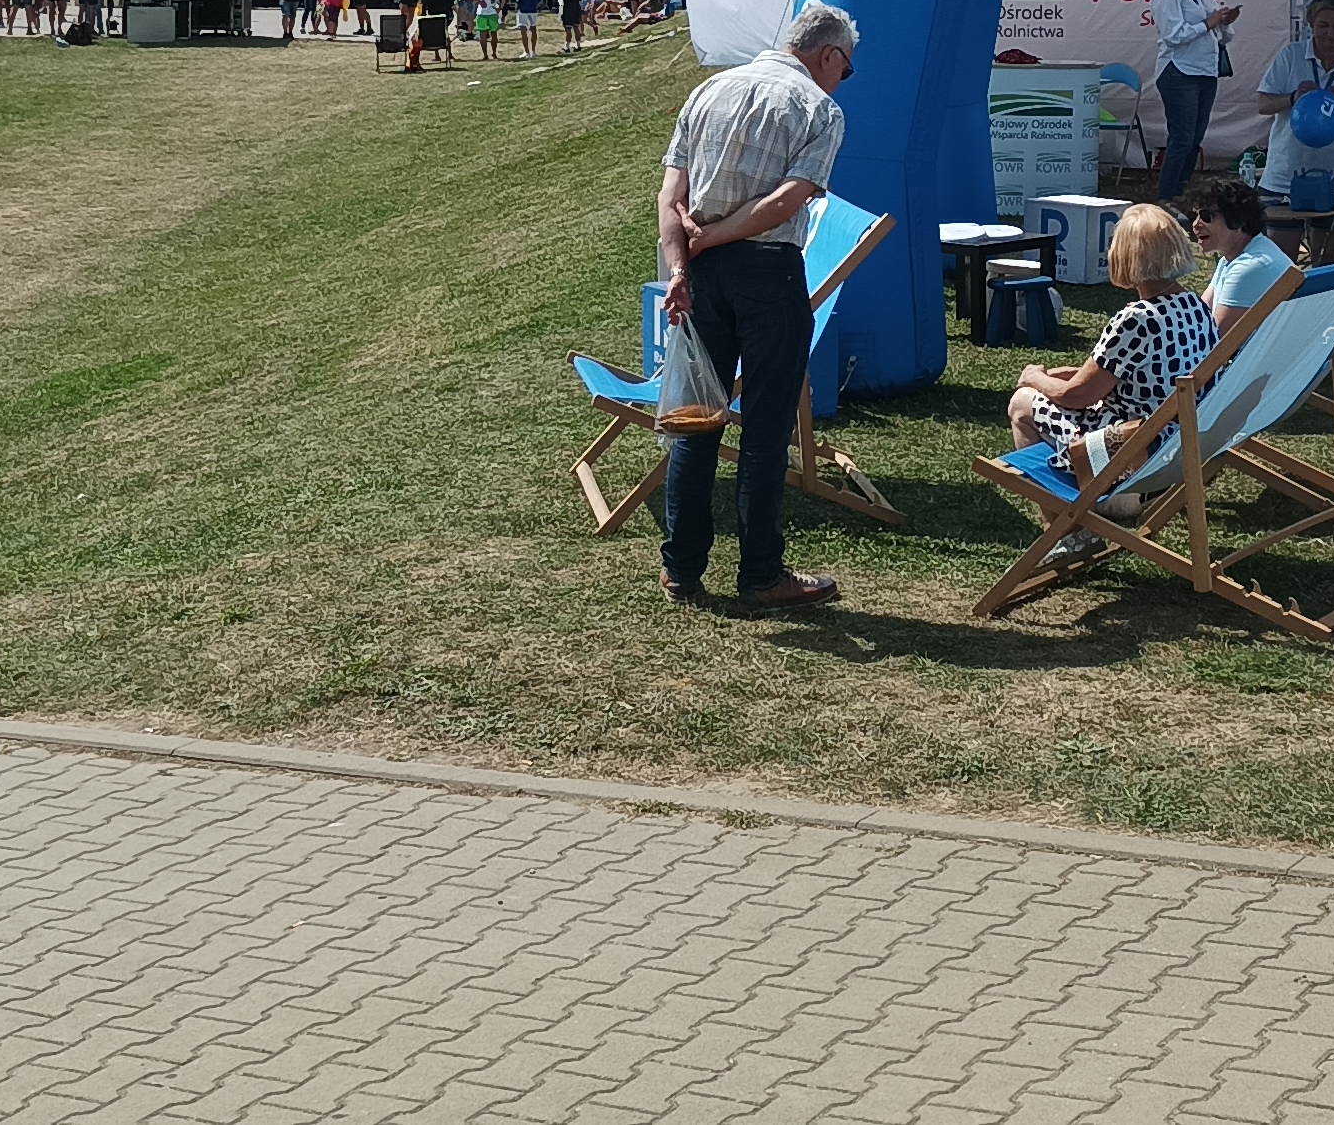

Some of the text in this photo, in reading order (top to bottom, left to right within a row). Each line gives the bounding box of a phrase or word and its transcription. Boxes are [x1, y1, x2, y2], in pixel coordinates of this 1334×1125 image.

[989, 119, 1073, 130] Krajowy Ośrodek
[1031, 131, 1073, 140] Rolnictwa
[995, 162, 1024, 172] OWR
[1036, 163, 1071, 173] KOWR
